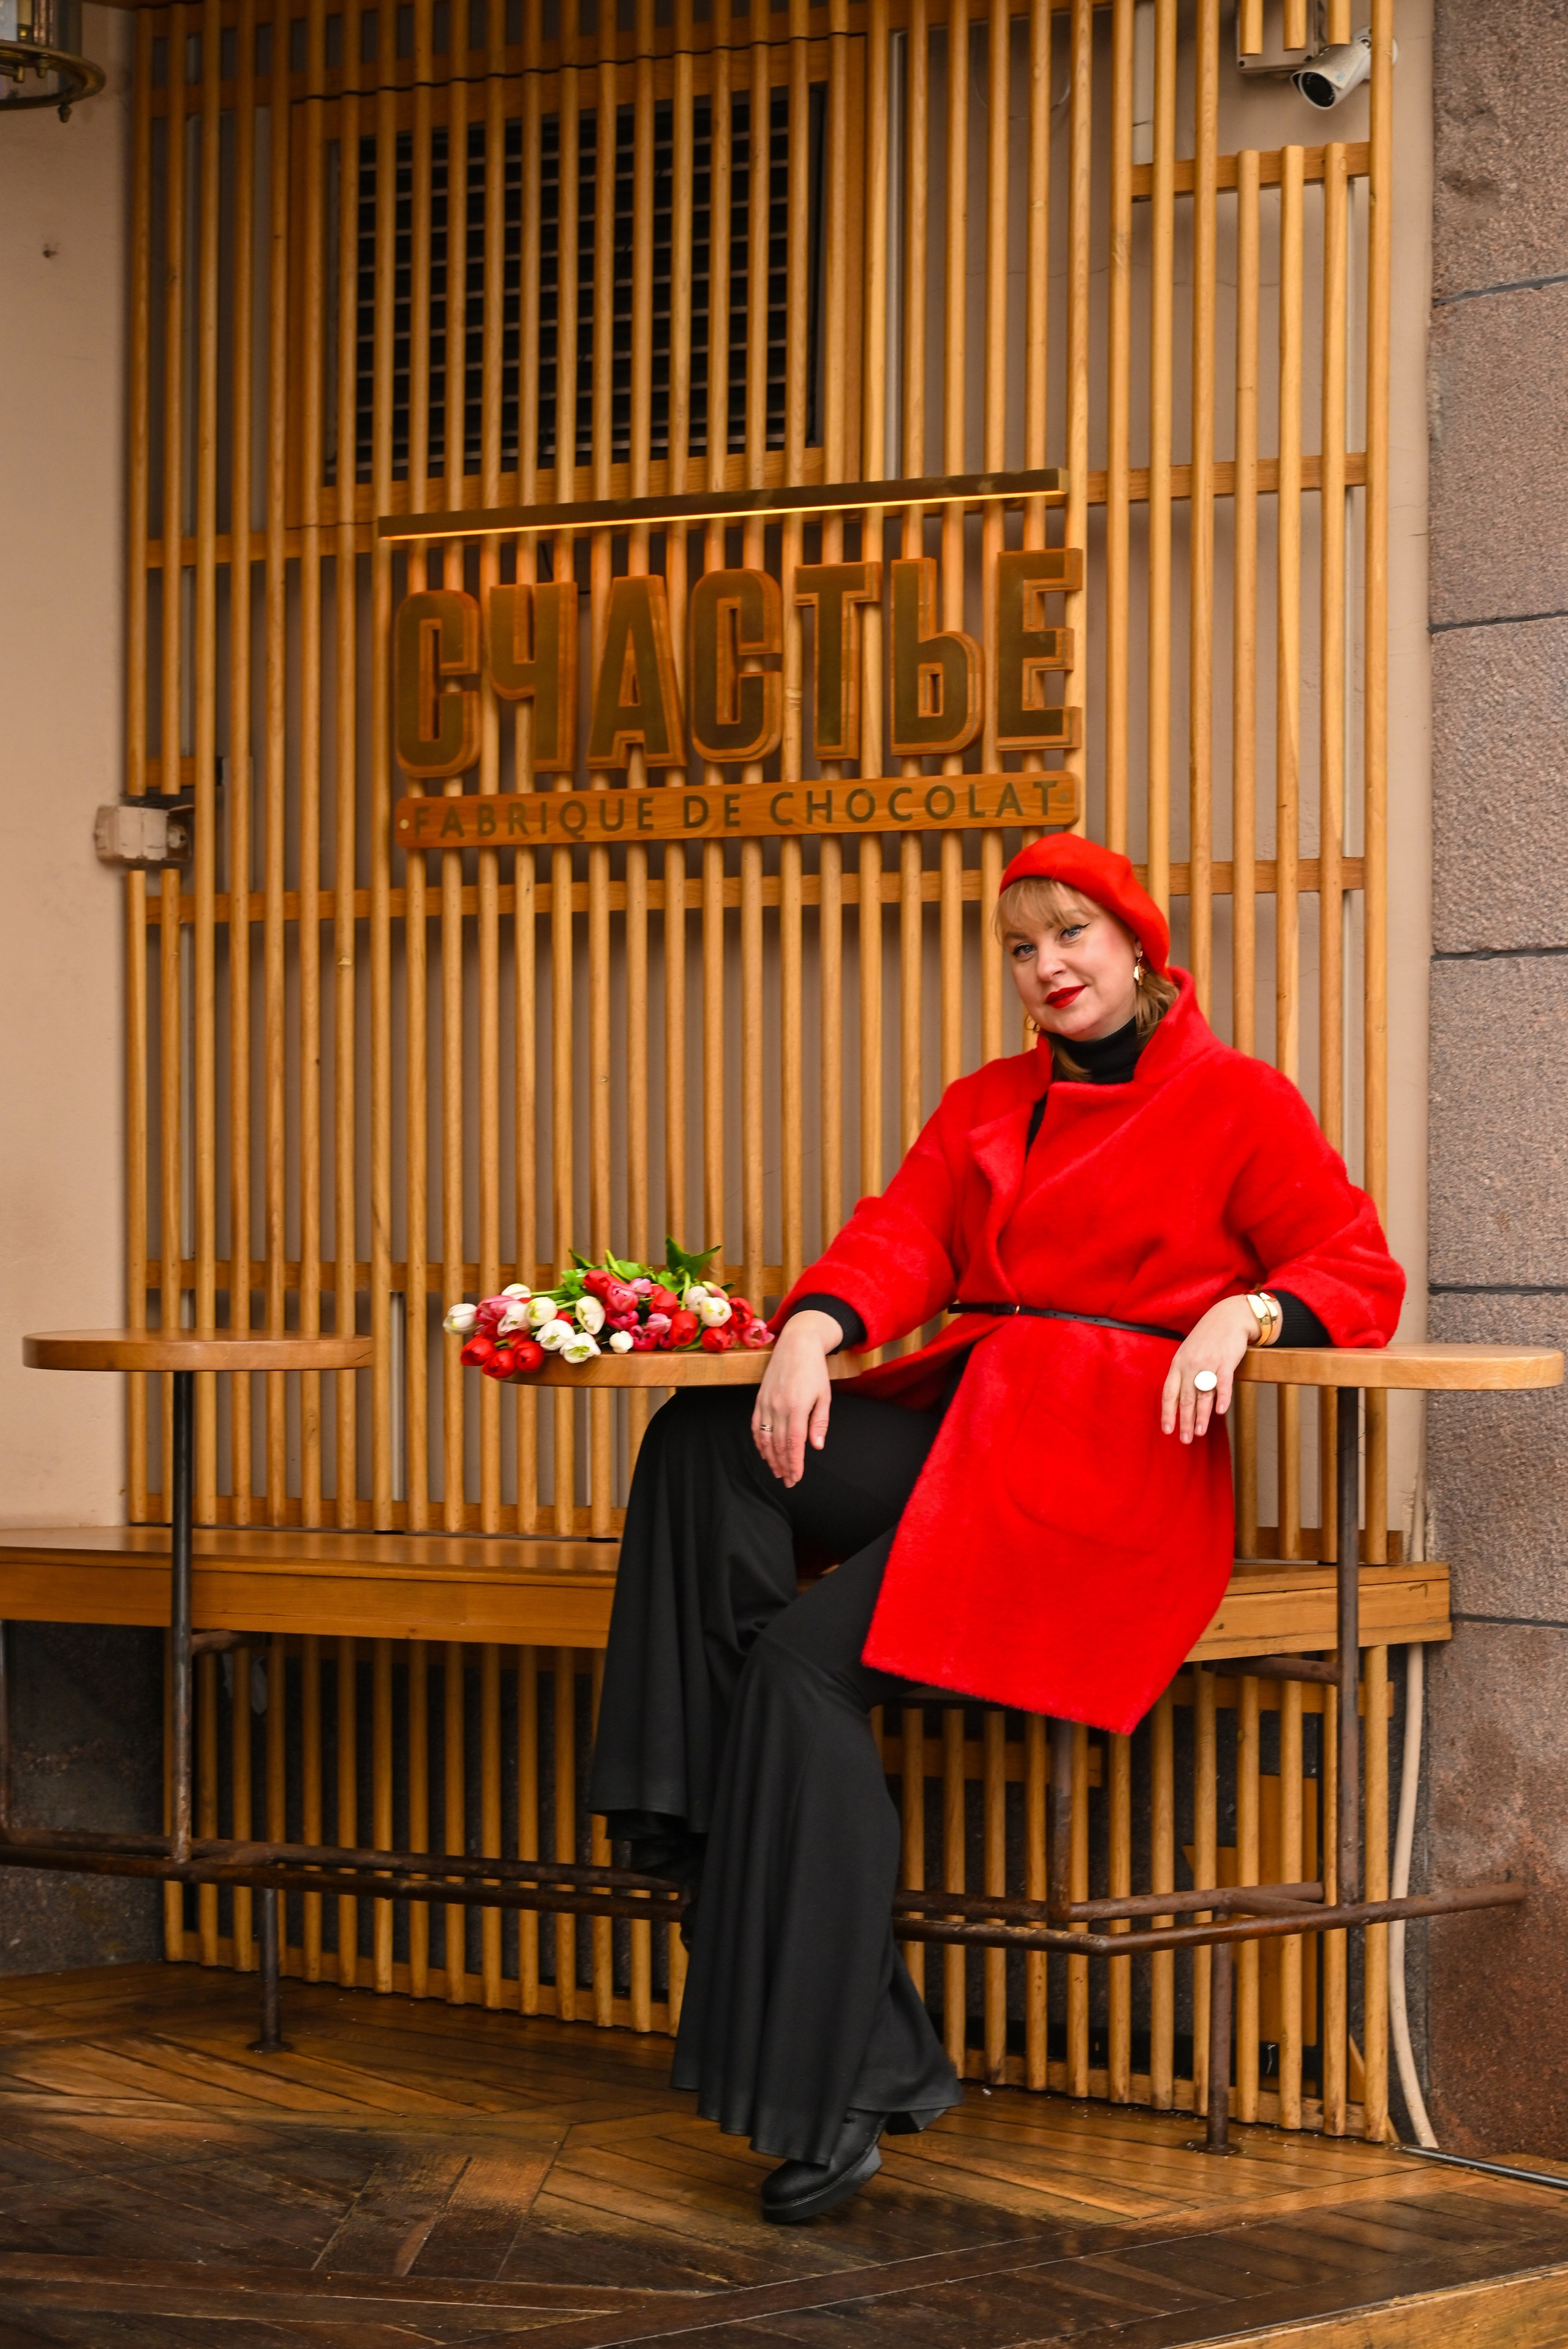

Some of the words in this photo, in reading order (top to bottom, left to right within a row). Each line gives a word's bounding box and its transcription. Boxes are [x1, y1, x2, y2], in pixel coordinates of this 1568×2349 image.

[395, 548, 1082, 778] СЧАСТЬЕ
[414, 797, 654, 840] FABRIQUE
[683, 793, 741, 829] DE
[770, 780, 1058, 826] CHOCOLAT
